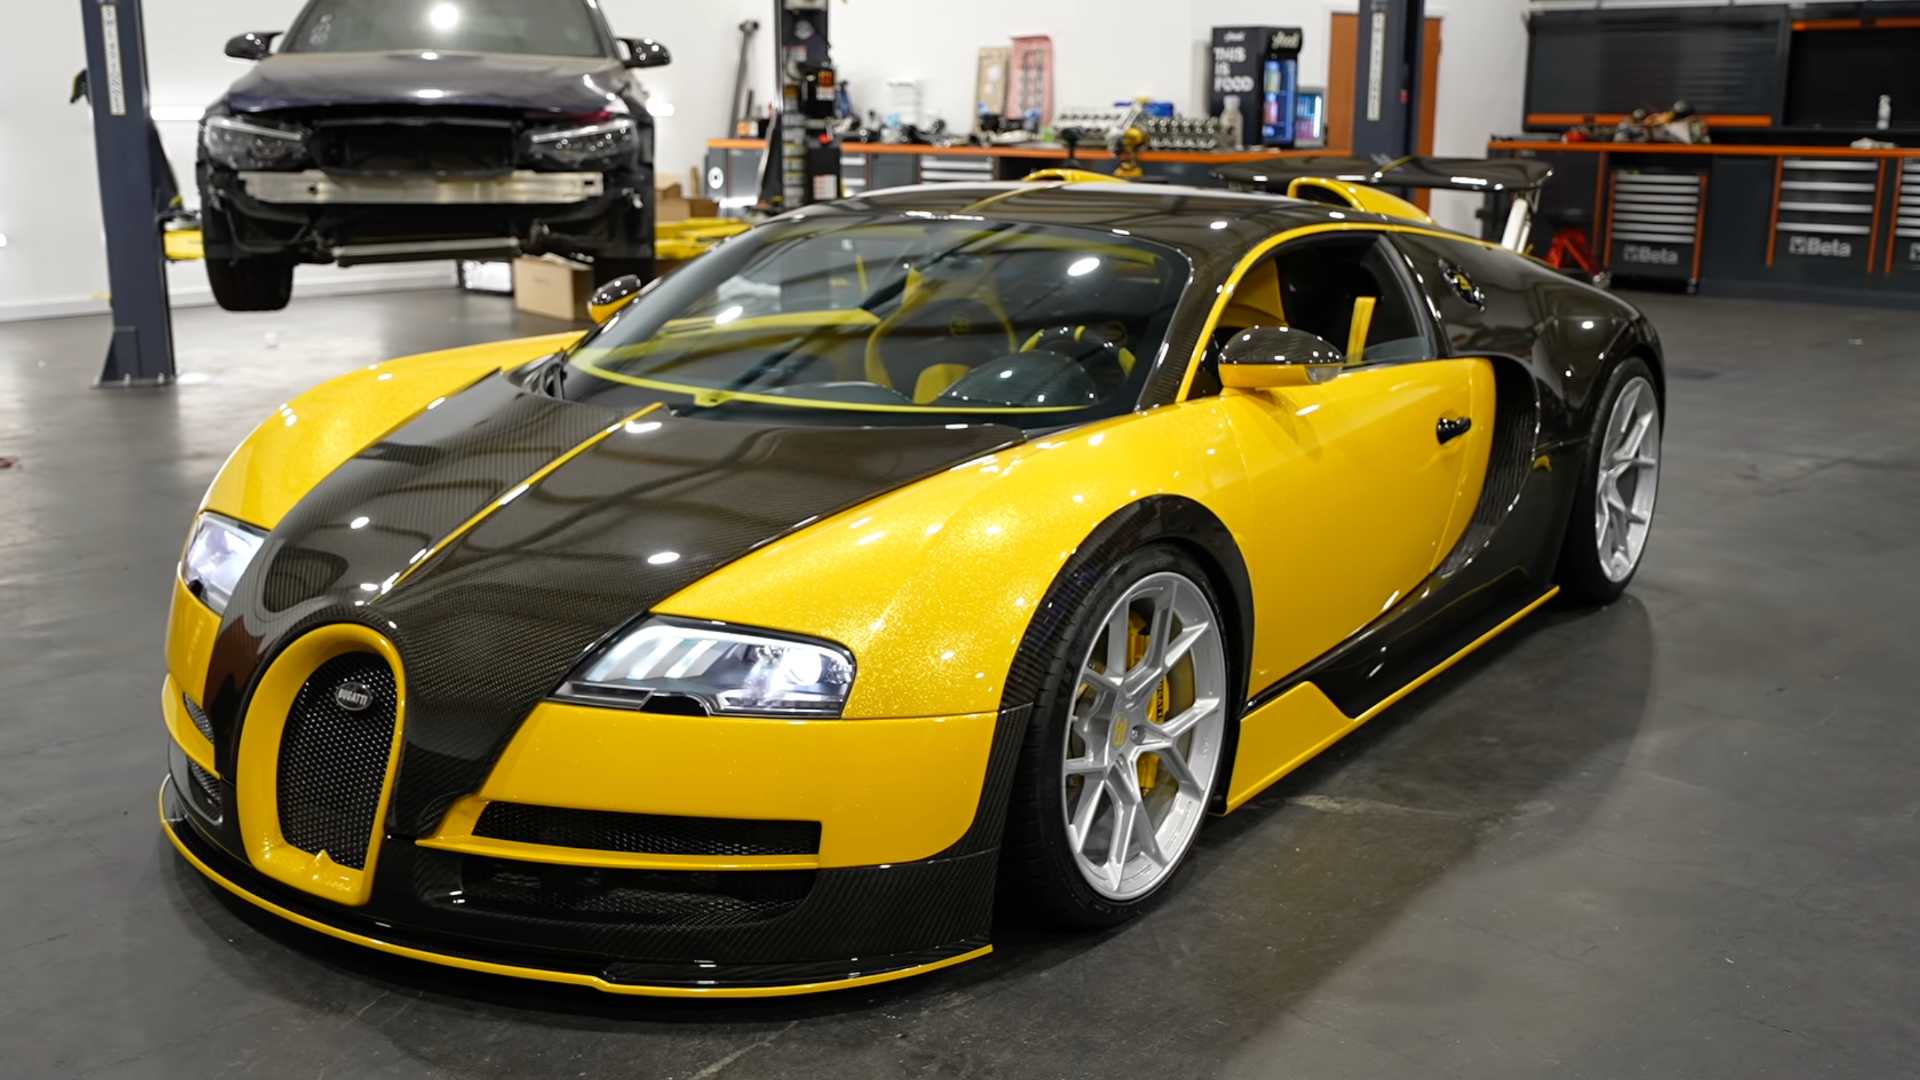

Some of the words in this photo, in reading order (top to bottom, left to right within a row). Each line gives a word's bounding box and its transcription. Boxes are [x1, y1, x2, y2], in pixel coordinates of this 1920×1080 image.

[1213, 46, 1246, 62] THIS
[1214, 62, 1230, 75] IS
[1214, 76, 1254, 92] FOOD
[1640, 245, 1678, 265] Beta
[1807, 237, 1851, 257] Beta
[338, 688, 368, 705] BUGATTI
